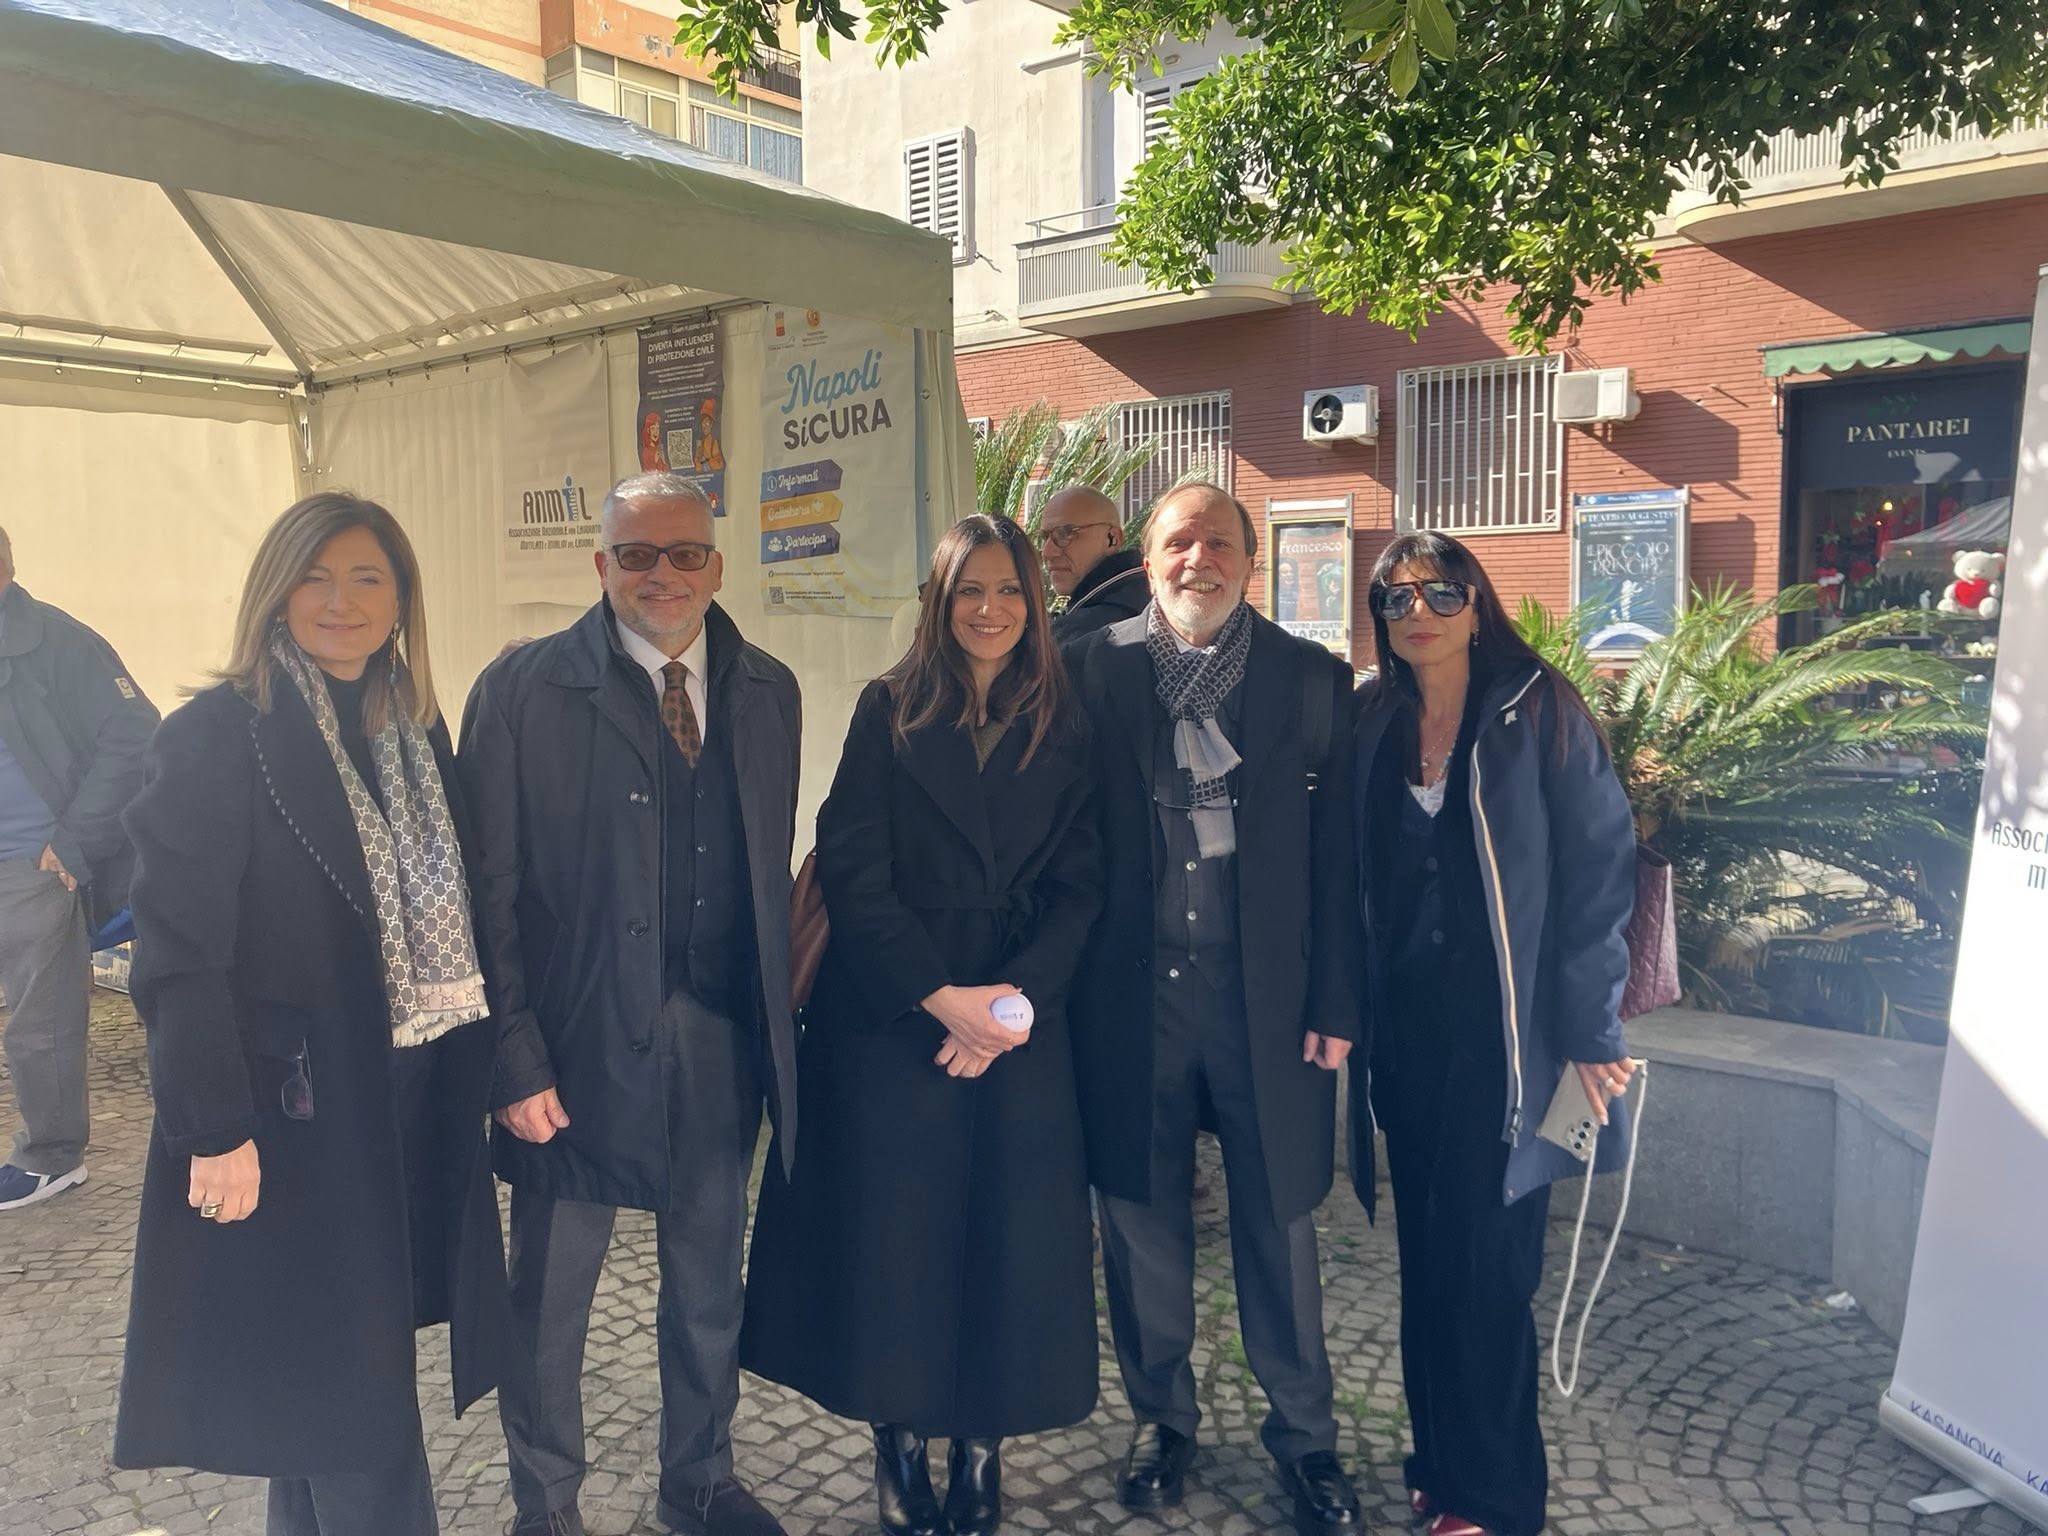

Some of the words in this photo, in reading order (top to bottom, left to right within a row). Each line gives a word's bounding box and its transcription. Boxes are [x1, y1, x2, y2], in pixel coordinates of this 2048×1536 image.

[648, 340, 673, 353] DIVENTA
[674, 332, 714, 348] INFLUENCER
[647, 355, 655, 365] DI
[655, 348, 695, 363] PROTEZIONE
[696, 344, 715, 356] CIVILE
[781, 348, 883, 415] Napoli
[783, 397, 892, 450] SiCURA
[1847, 417, 1972, 444] PANTAREI
[778, 469, 819, 491] Informati
[1588, 513, 1625, 523] TEATRO
[784, 533, 827, 552] Partecipa
[1279, 540, 1343, 555] Francesco
[1597, 541, 1669, 561] PICCOLO
[1286, 622, 1310, 630] TEATRO
[1910, 1400, 2005, 1468] KASANOVA
